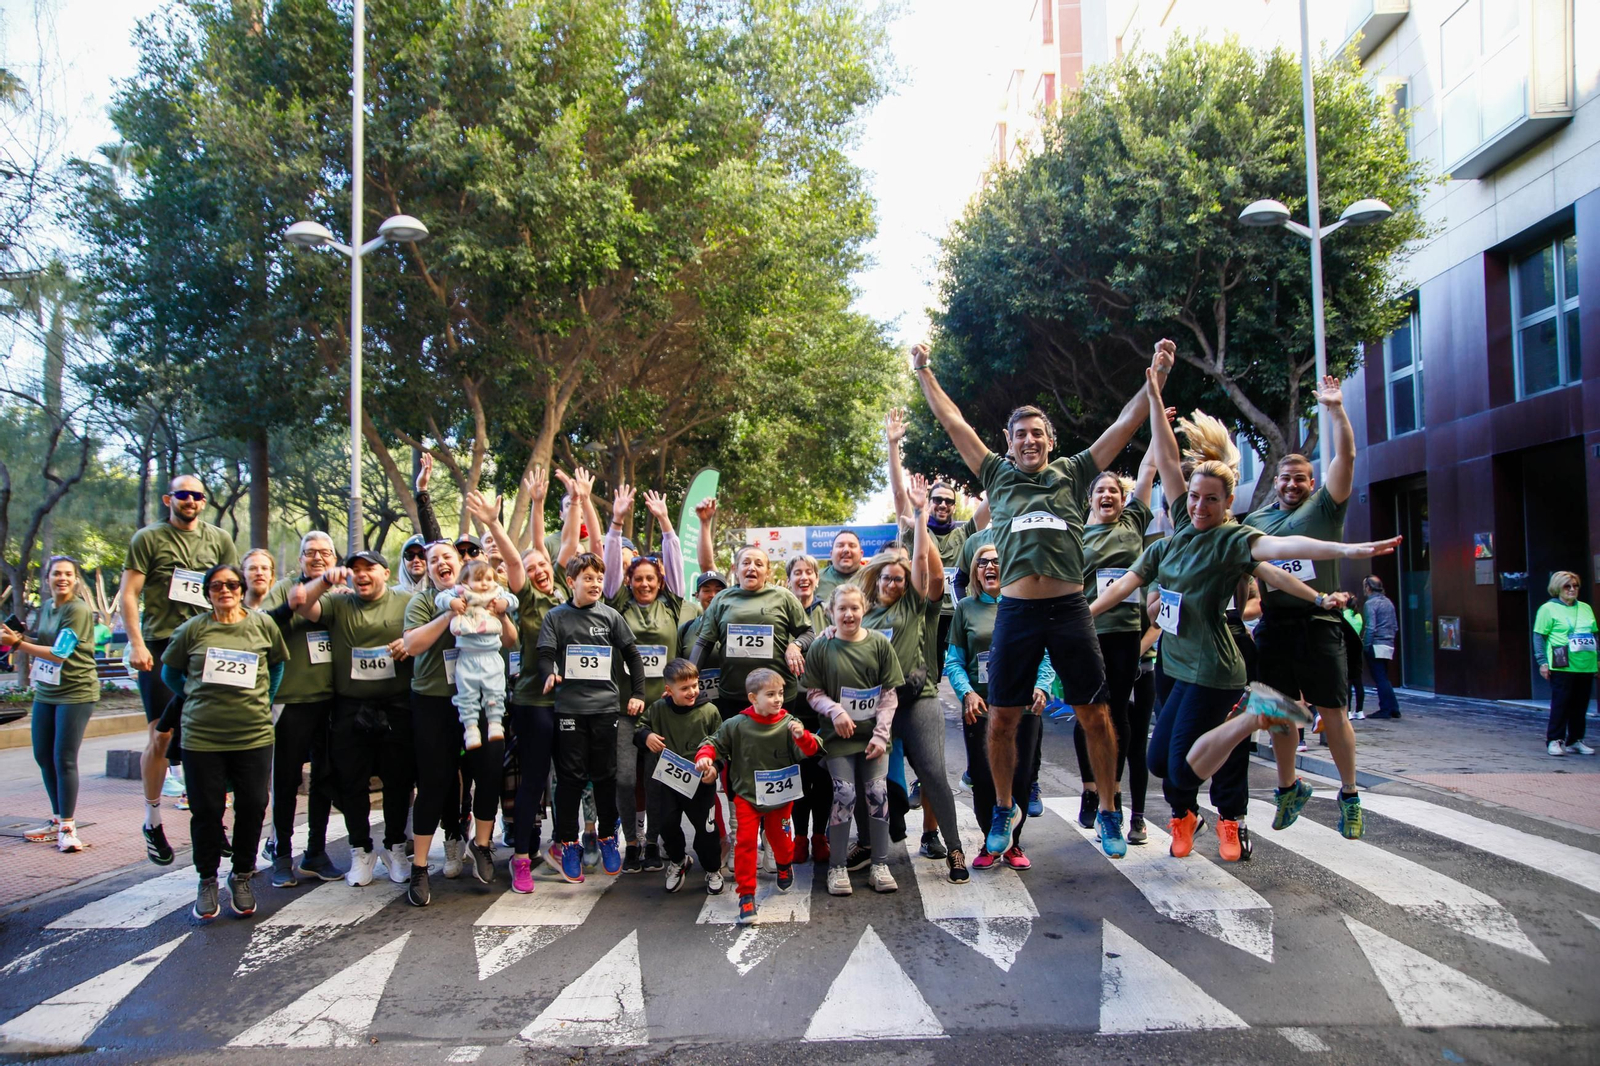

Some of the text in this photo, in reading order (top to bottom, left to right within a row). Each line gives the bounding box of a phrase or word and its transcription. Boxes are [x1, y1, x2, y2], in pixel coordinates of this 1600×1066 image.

[811, 529, 842, 538] Almer
[812, 538, 886, 548] cont áncer
[1282, 560, 1302, 573] 68
[182, 581, 201, 594] 15
[1161, 602, 1170, 619] 21
[318, 641, 332, 652] 56
[736, 635, 764, 648] 125
[214, 660, 246, 675] 223
[360, 658, 386, 669] 846
[579, 656, 599, 668] 93
[642, 656, 659, 667] 29
[39, 663, 54, 675] 414
[849, 698, 875, 710] 160
[664, 762, 692, 784] 250
[765, 777, 793, 794] 234
